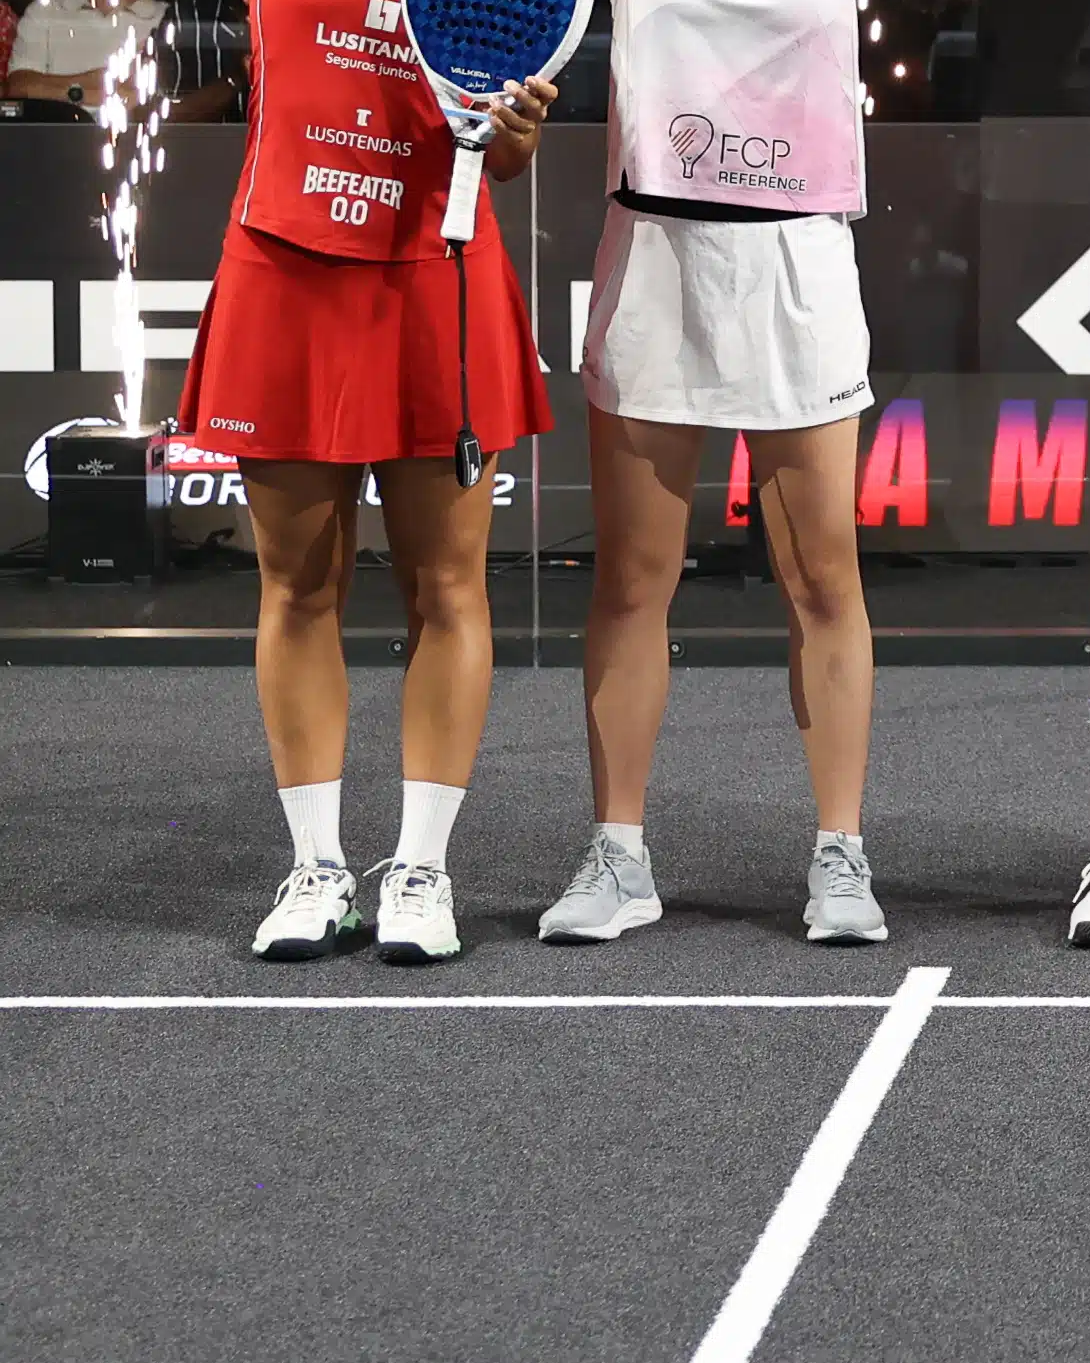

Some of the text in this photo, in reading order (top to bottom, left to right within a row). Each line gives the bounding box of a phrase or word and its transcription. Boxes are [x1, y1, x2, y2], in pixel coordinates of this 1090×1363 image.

[325, 51, 418, 82] Seguros juntos
[305, 124, 413, 158] LUSOTENDAS
[719, 133, 792, 171] FCP
[303, 164, 405, 211] BEEFEATER
[718, 170, 807, 192] REFERENCE
[330, 195, 369, 227] 0.0
[829, 380, 866, 404] HEAD
[209, 416, 257, 435] OYSHO
